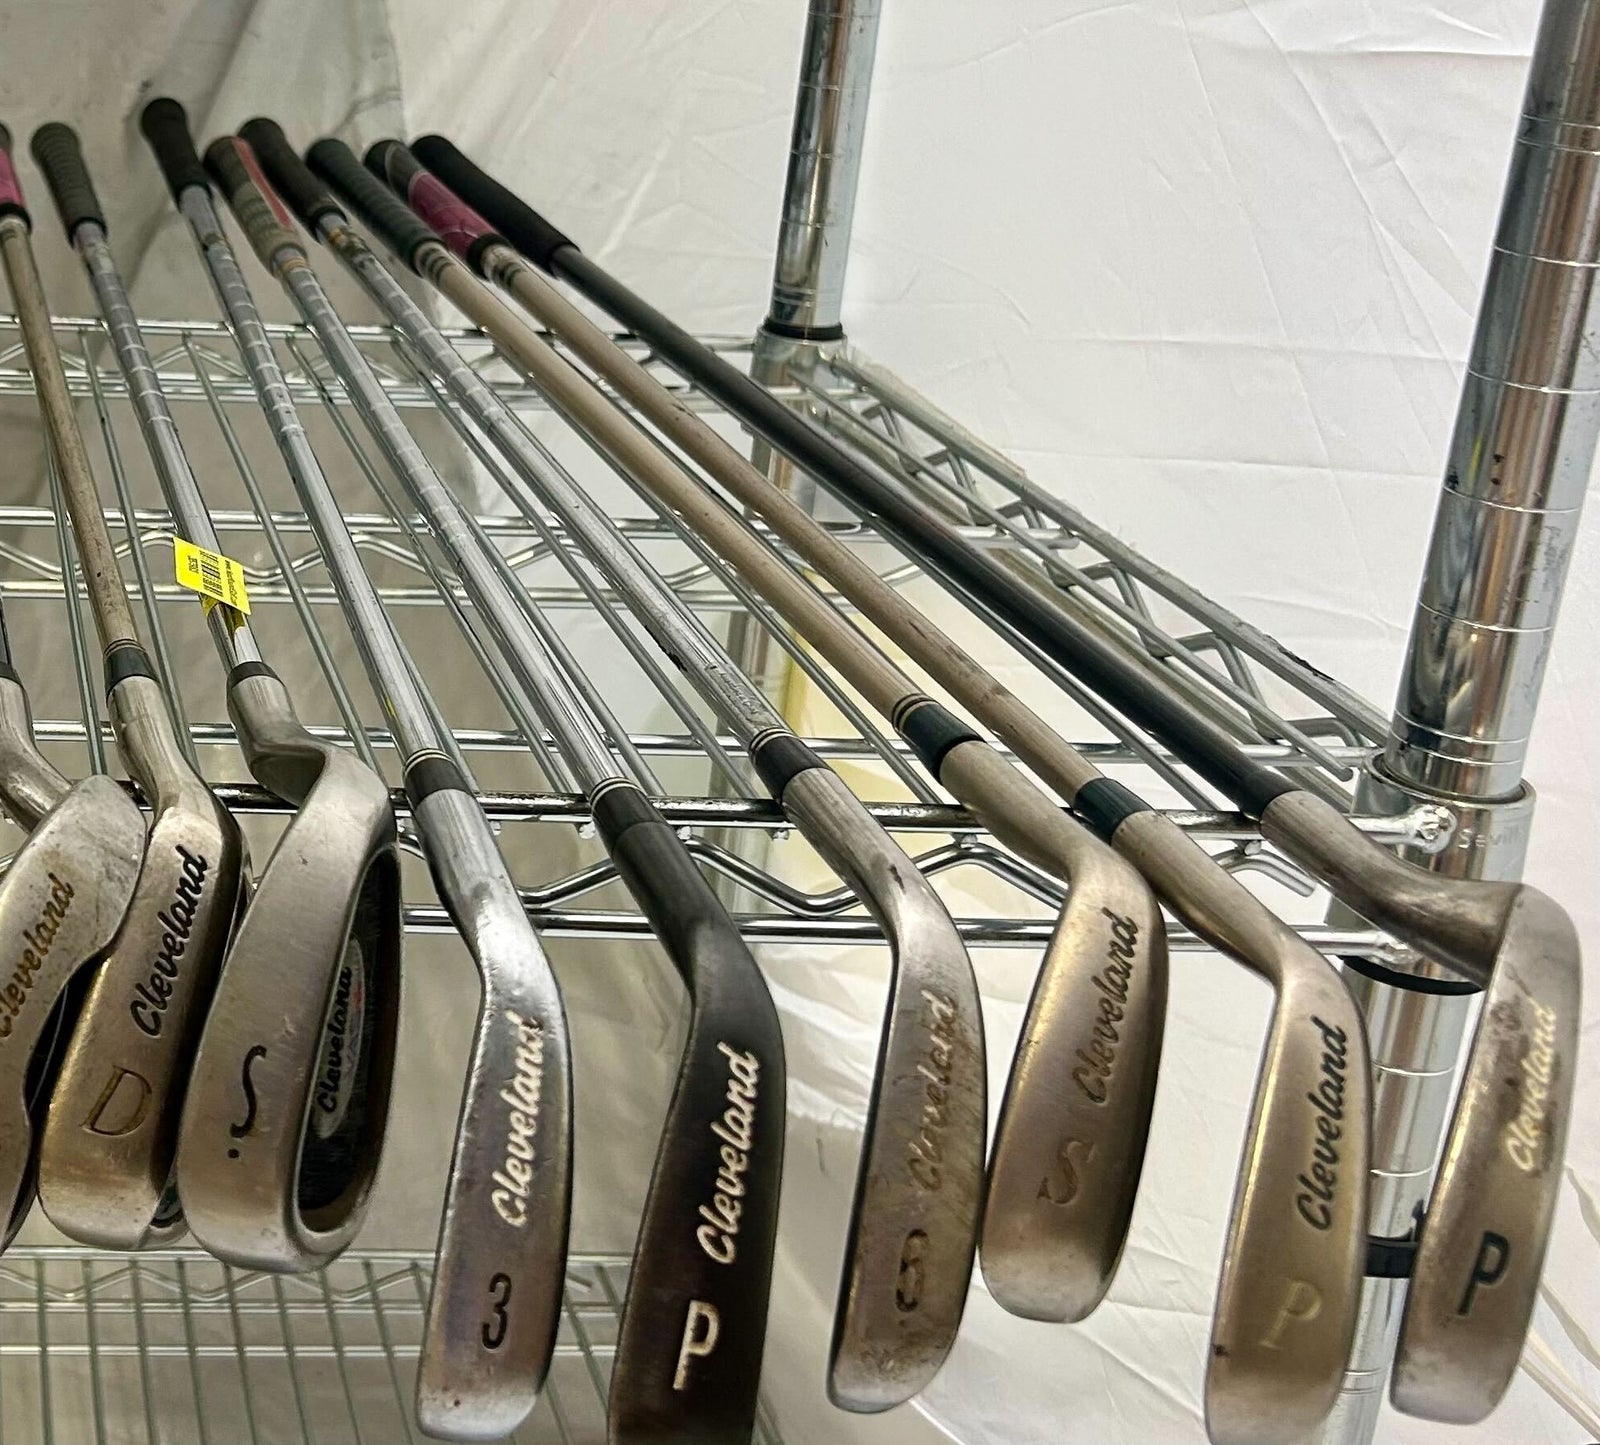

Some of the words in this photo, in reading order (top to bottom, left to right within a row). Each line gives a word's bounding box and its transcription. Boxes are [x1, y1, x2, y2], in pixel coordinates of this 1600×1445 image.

[130, 845, 209, 1038] Cleveland
[1071, 906, 1140, 1105] Cleveland
[80, 1065, 153, 1137] D
[490, 1010, 545, 1229] Cleveland
[696, 1041, 762, 1266] Cleveland
[907, 988, 960, 1193] Cleveland
[1036, 1137, 1097, 1207] S
[1296, 1014, 1350, 1234] Cleveland
[1505, 994, 1558, 1173] Cleveland
[481, 1272, 514, 1351] 3
[672, 1299, 721, 1392] P
[1255, 1278, 1322, 1351] P
[1457, 1230, 1510, 1318] P
